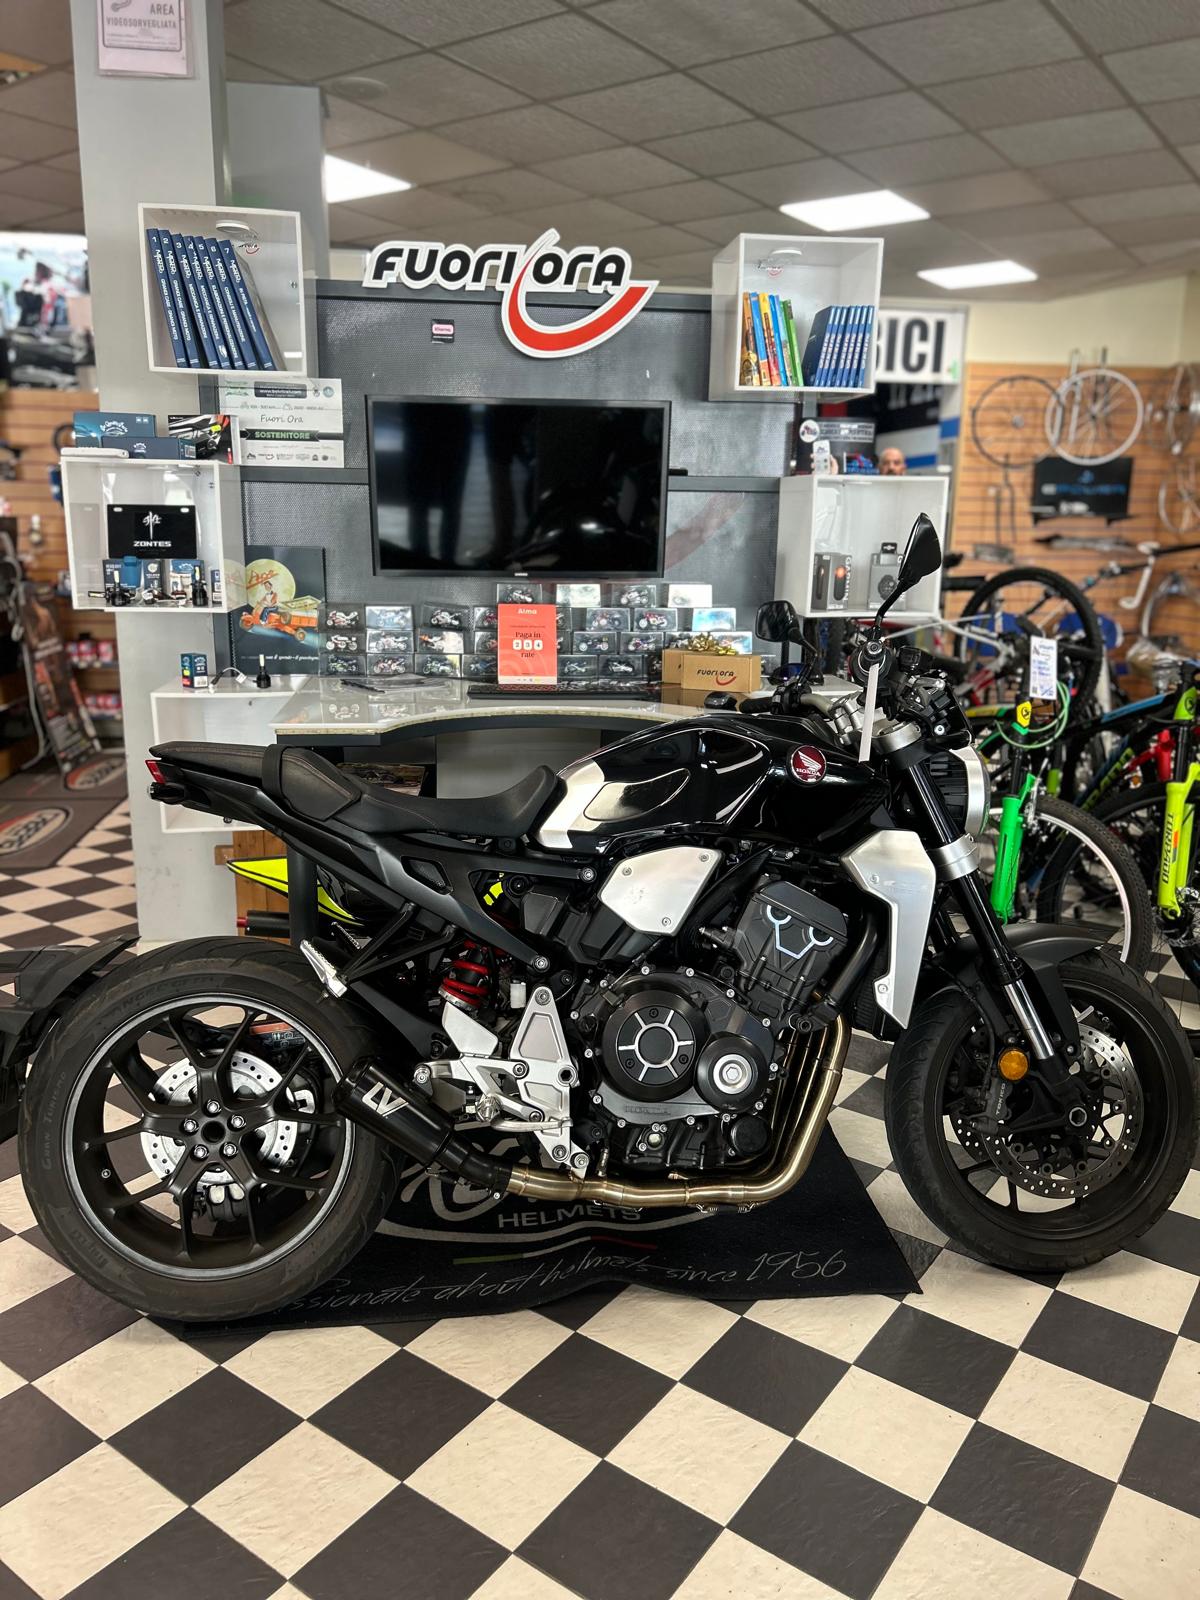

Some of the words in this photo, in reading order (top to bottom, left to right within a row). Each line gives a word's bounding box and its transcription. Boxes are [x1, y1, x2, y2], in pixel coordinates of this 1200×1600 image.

[150, 3, 175, 15] AREA
[106, 16, 177, 28] VIDEOSORVEGLIATA
[372, 247, 518, 284] FUORI
[532, 252, 626, 287] ORA
[260, 414, 285, 423] Fuori
[287, 415, 303, 423] Ora
[255, 431, 310, 439] SOSTENITORE
[515, 631, 532, 639] Paga
[796, 768, 821, 777] HONDA
[498, 1204, 641, 1228] HELMETS
[433, 1262, 546, 1301] about
[666, 1266, 737, 1282] since
[746, 1250, 848, 1281] 1956
